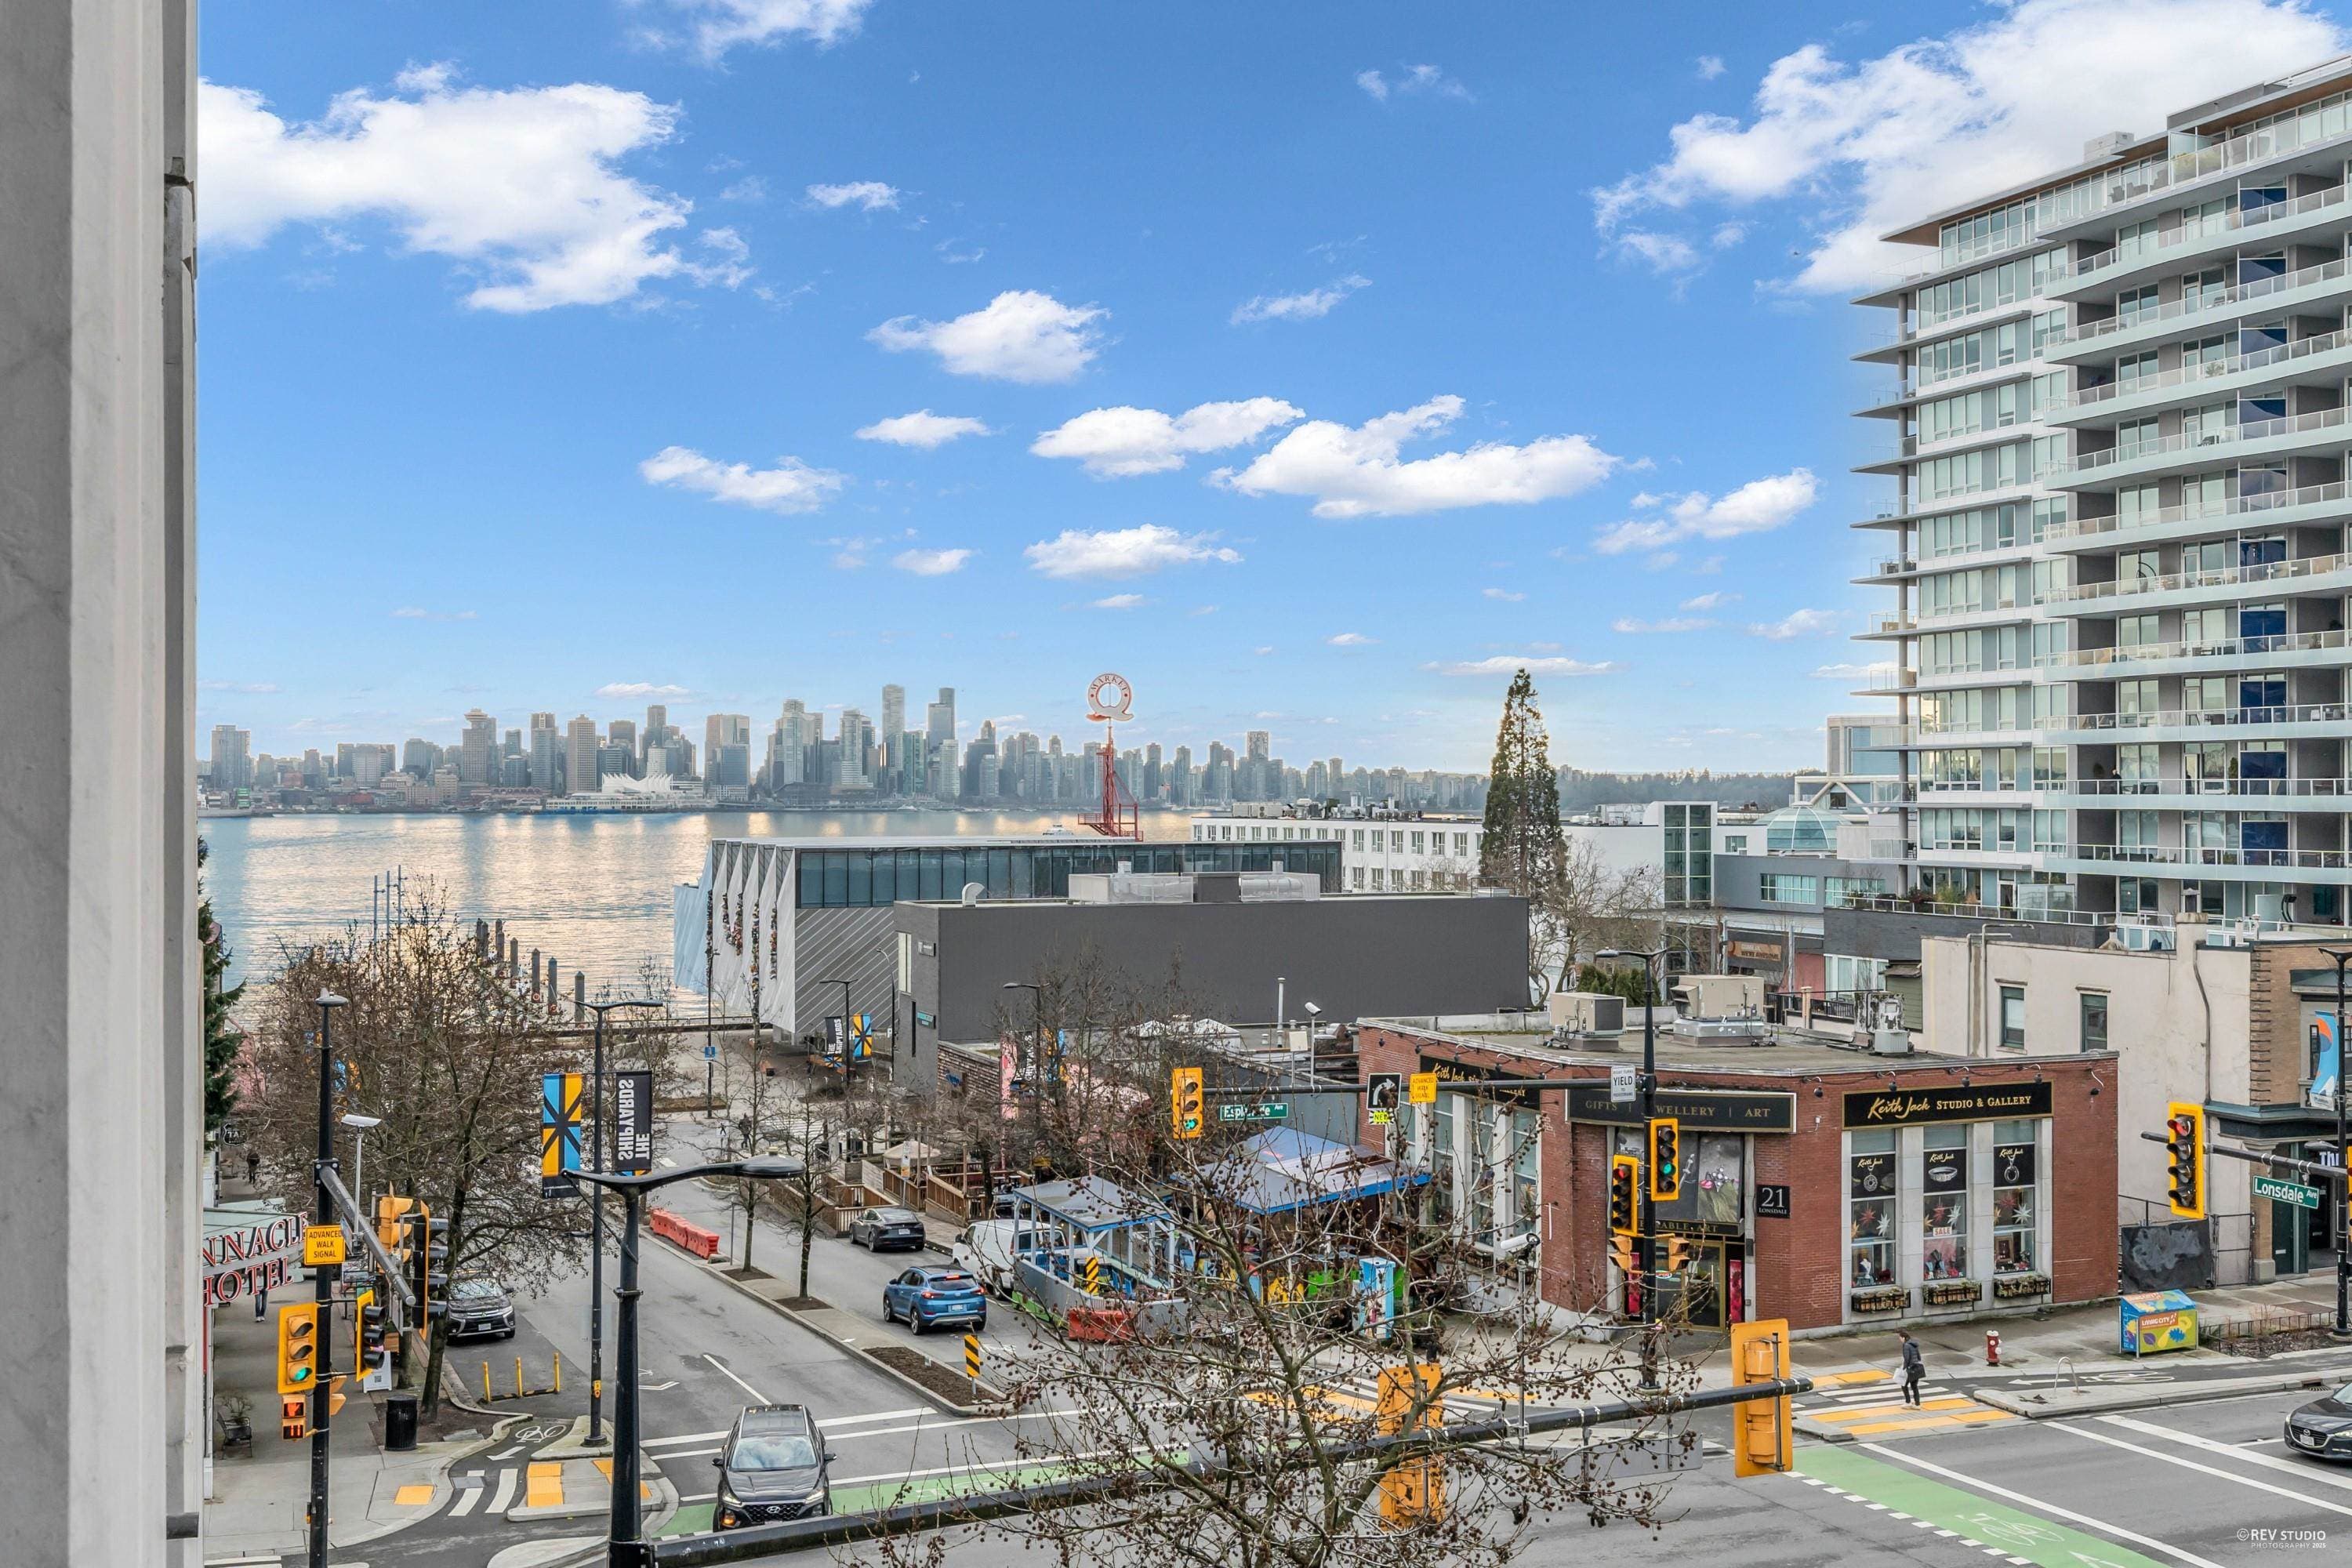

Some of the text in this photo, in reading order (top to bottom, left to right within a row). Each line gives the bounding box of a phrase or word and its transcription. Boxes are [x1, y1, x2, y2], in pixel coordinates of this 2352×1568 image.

[1091, 674, 1129, 691] MARKET
[1613, 1076, 1633, 1086] YIELD
[1224, 1105, 1271, 1120] Esplde
[1585, 1100, 1771, 1117] GIFTS WELLERY ART
[1867, 1096, 2031, 1120] Keith Jack STUDIO & GALLERY
[1762, 1187, 1785, 1207] 21
[2254, 1178, 2318, 1203] Lonsdale Ave
[202, 1212, 309, 1267] NNACLE
[314, 1250, 336, 1258] SIGNAL
